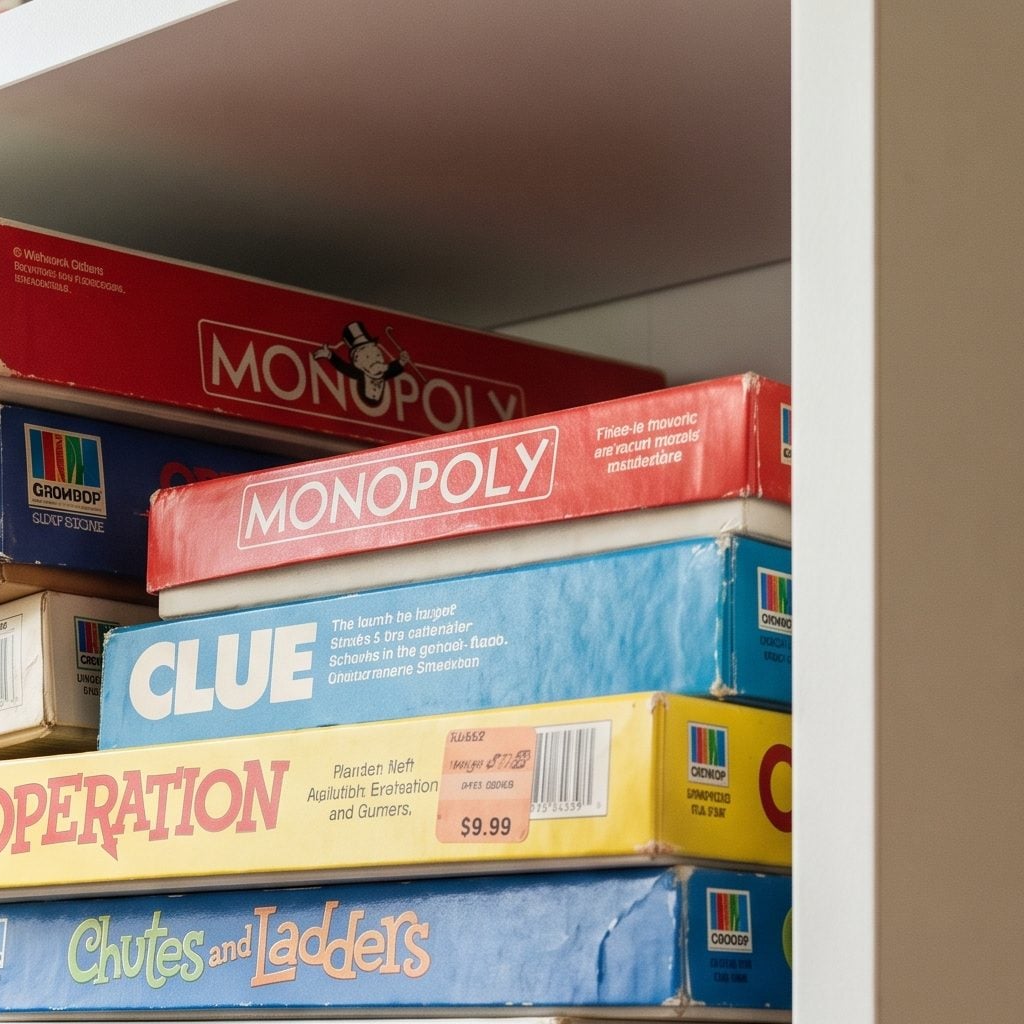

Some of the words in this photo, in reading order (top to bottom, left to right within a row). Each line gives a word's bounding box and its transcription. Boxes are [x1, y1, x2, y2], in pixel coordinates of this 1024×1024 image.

[244, 438, 549, 539] MONOPOLY
[332, 619, 354, 632] The
[382, 648, 393, 660] in
[397, 645, 416, 658] the
[129, 622, 317, 720] CLUE
[329, 805, 354, 820] and
[461, 817, 511, 838] $9.99
[67, 911, 205, 988] Chutes
[208, 924, 252, 967] and
[251, 901, 430, 988] Ladders
